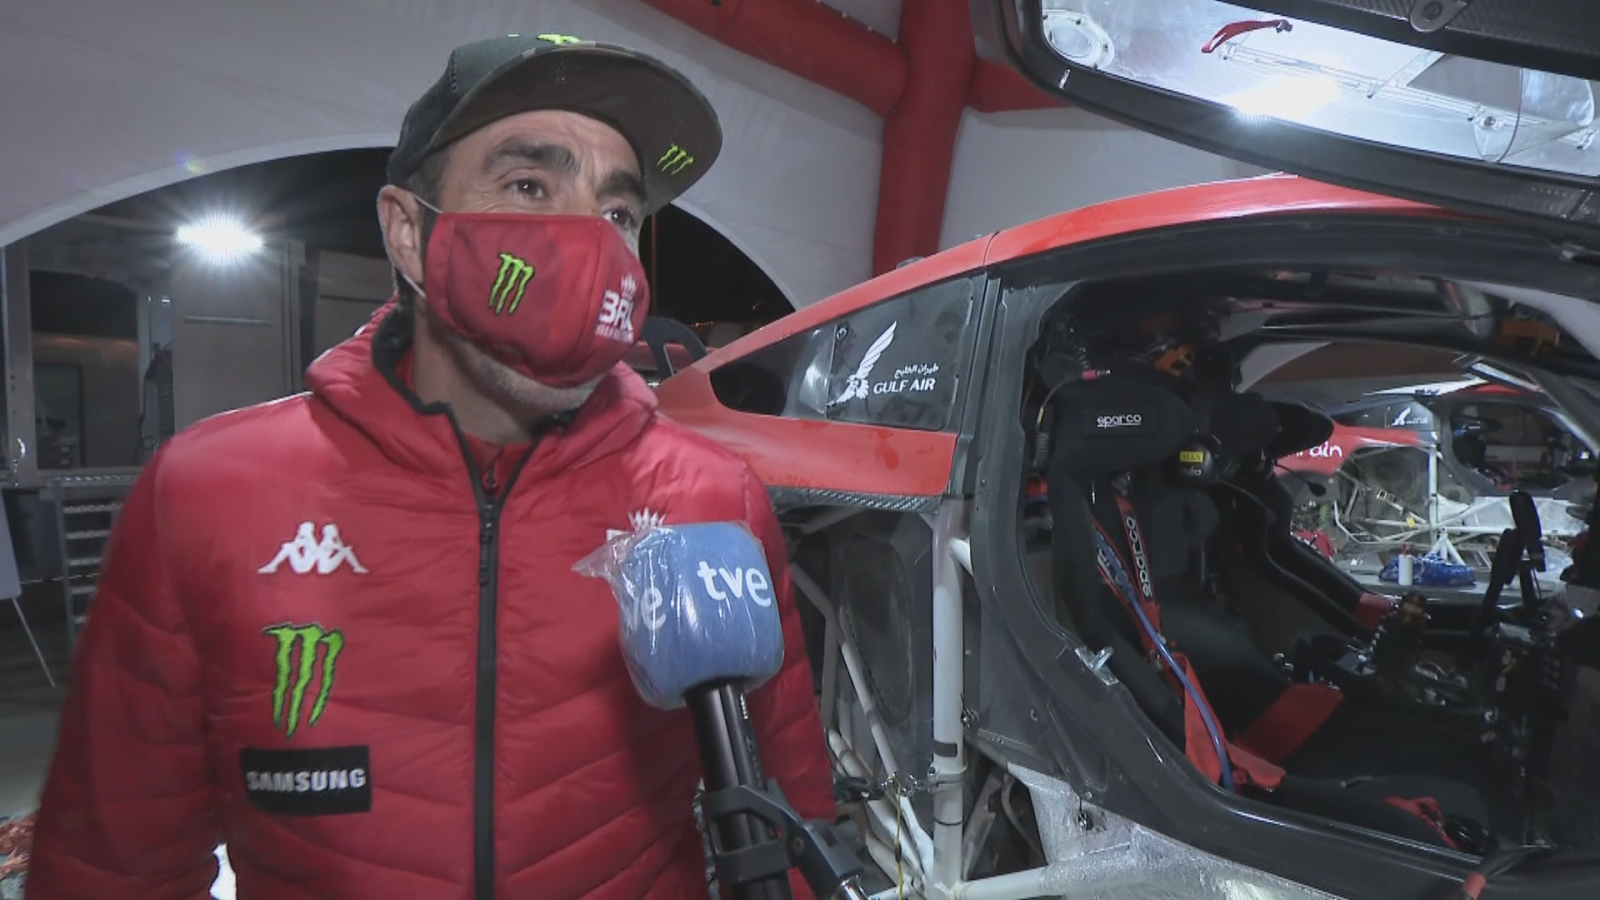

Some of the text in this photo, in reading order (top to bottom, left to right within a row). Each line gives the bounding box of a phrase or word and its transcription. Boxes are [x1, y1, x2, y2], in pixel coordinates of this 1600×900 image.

[873, 378, 936, 394] GULF AIR
[1096, 414, 1142, 429] sparco
[697, 561, 772, 607] tve
[246, 768, 366, 792] SAMSUNG
